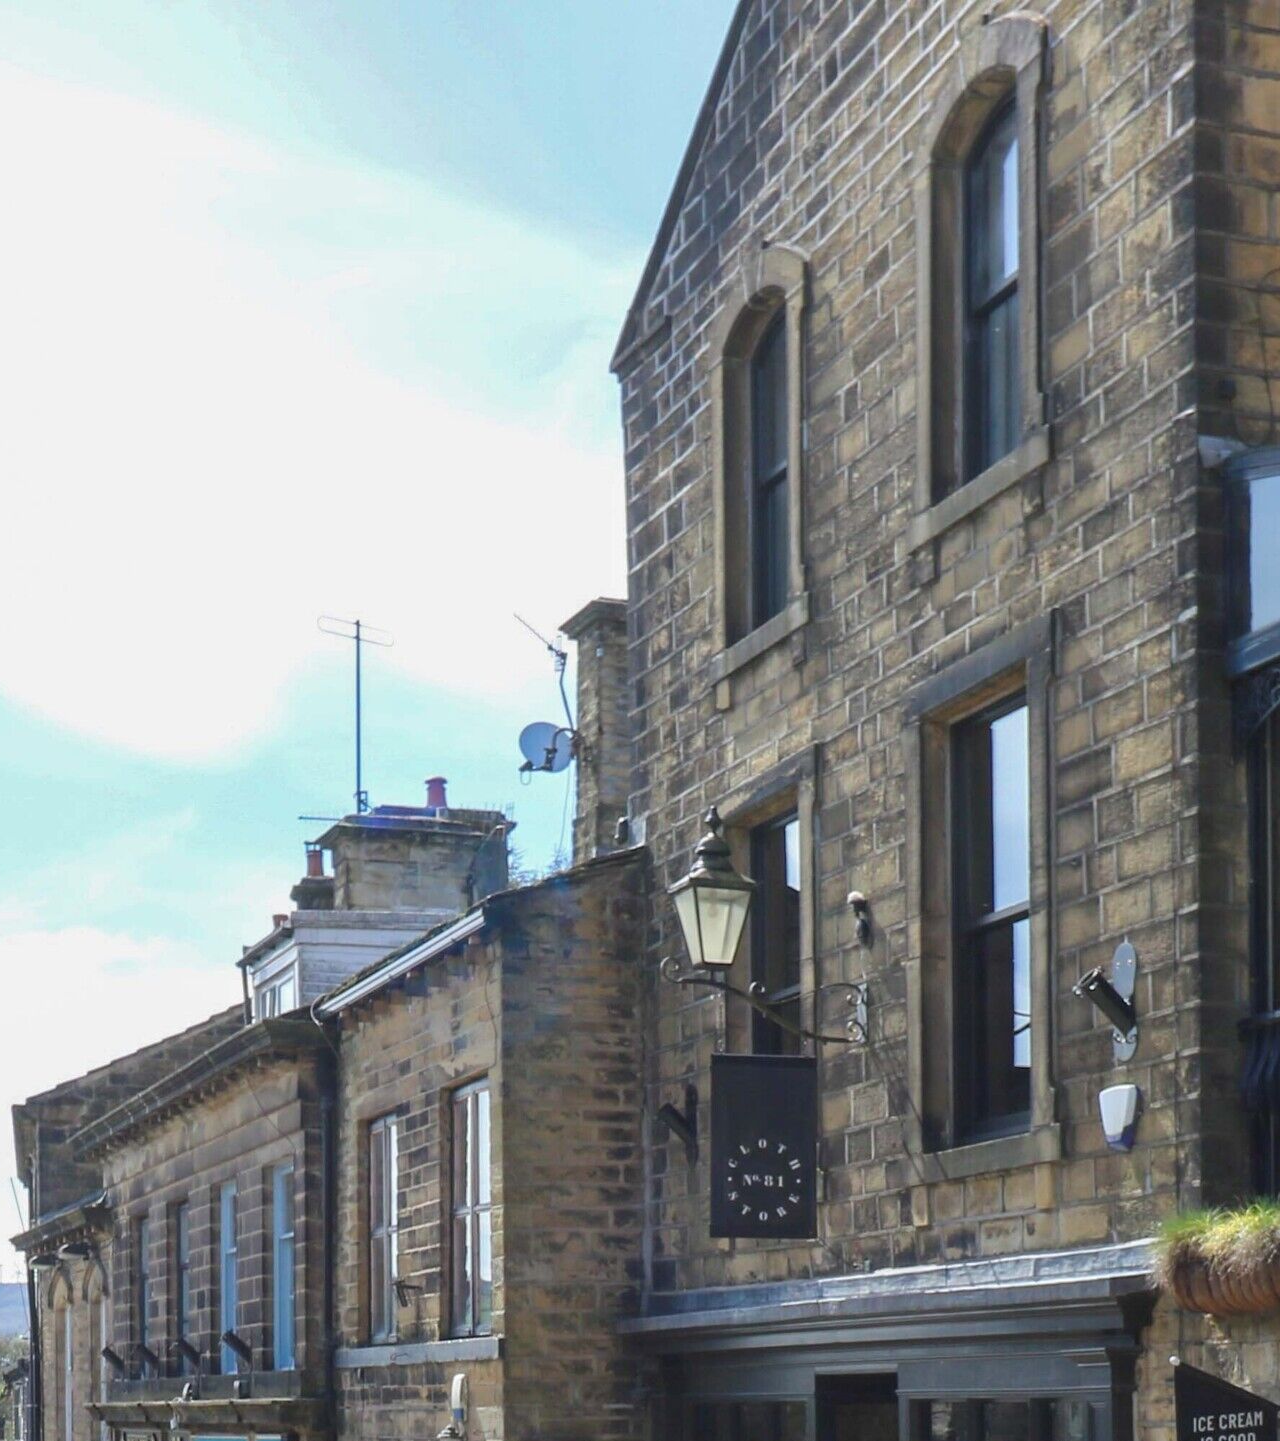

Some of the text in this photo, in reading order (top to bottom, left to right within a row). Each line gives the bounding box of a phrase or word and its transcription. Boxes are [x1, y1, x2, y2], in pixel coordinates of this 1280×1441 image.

[728, 1139, 801, 1170] CLOTH
[728, 1191, 799, 1221] STORE
[1192, 1411, 1263, 1433] ICE CREAM
